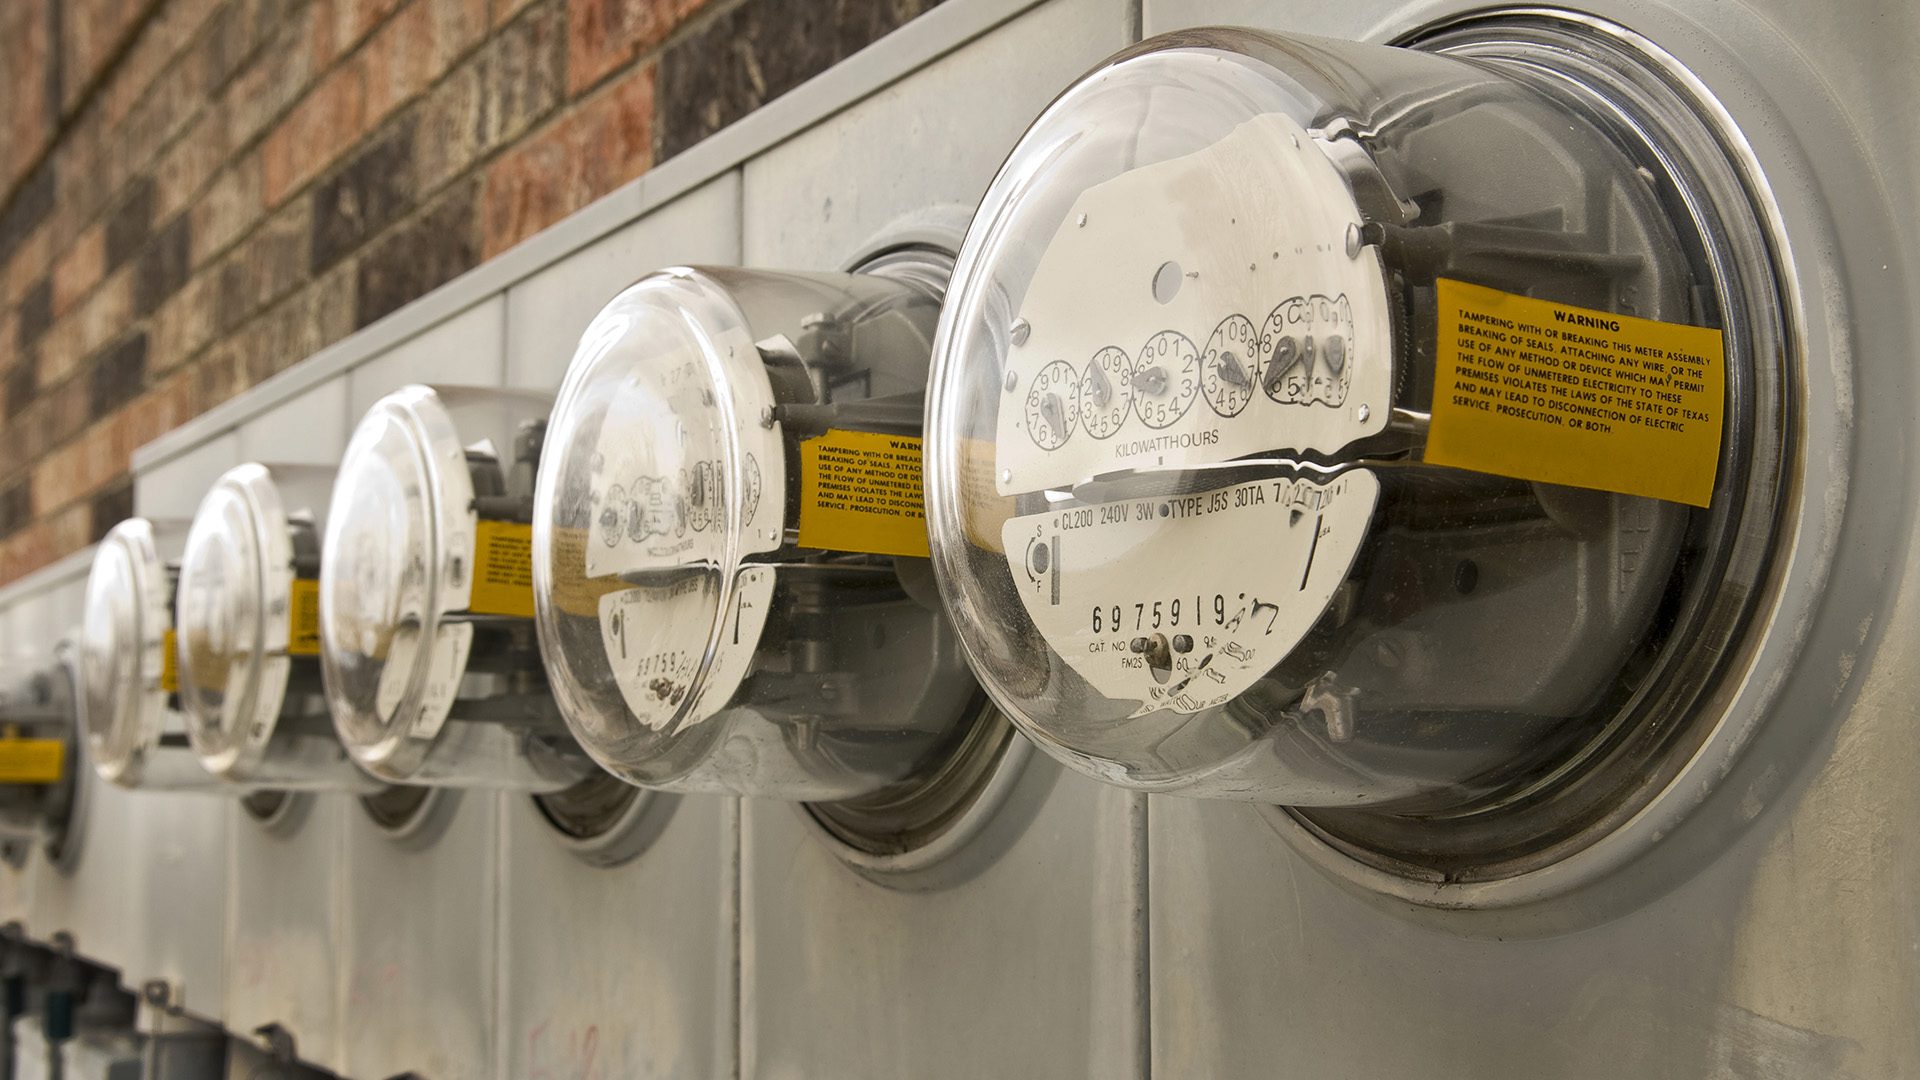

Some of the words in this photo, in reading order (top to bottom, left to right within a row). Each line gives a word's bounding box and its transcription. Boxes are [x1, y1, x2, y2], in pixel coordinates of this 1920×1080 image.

[1273, 314, 1283, 334] 9
[1554, 310, 1620, 332] WARNING
[1219, 329, 1223, 347] 1
[1229, 321, 1237, 340] 0
[1240, 324, 1247, 343] 9
[1458, 309, 1514, 329] TAMPERING
[1518, 323, 1541, 335] WITH
[1545, 328, 1558, 339] OR
[1561, 331, 1609, 349] BREAKING
[1612, 342, 1632, 352] THIS
[1634, 346, 1663, 358] METER
[1667, 352, 1710, 366] ASSEMBLY
[1158, 337, 1167, 356] 0
[1173, 339, 1179, 357] 1
[1247, 338, 1255, 358] 8
[1263, 334, 1271, 353] 8
[1458, 323, 1506, 342] BREAKING
[1510, 335, 1523, 345] OF
[1561, 346, 1615, 364] ATTACHING
[1619, 357, 1639, 367] ANY
[1671, 365, 1684, 376] OR
[1687, 369, 1703, 379] THE
[1103, 353, 1111, 371] 0
[1113, 355, 1121, 373] 9
[1146, 346, 1154, 365] 9
[1182, 354, 1193, 373] 2
[1207, 349, 1217, 368] 2
[1457, 338, 1474, 349] USE
[1478, 342, 1492, 352] OF
[1495, 346, 1516, 358] ANY
[1519, 352, 1560, 367] METHOD
[1563, 360, 1576, 371] OR
[1580, 364, 1612, 377] DEVICE
[1615, 370, 1646, 383] WHICH
[1649, 376, 1670, 387] MAY
[1674, 380, 1704, 393] PERMIT
[1040, 374, 1048, 391] 9
[1052, 367, 1059, 383] 0
[1064, 368, 1068, 384] 1
[1121, 368, 1129, 386] 8
[1208, 374, 1217, 394] 3
[1248, 365, 1254, 385] 7
[1457, 352, 1474, 364] THE
[1478, 356, 1505, 370] FLOW
[1508, 363, 1520, 373] OF
[1524, 366, 1579, 385] UNMETERED
[1582, 378, 1637, 395] ELECTRICITY
[1640, 388, 1653, 398] TO
[1656, 391, 1682, 404] THESE
[1069, 382, 1076, 400] 2
[1084, 377, 1093, 396] 2
[1181, 379, 1192, 398] 3
[1288, 376, 1300, 396] 5
[1456, 366, 1499, 383] PREMISES
[1503, 376, 1547, 393] VIOLATES
[1551, 385, 1567, 397] THE
[1571, 390, 1597, 402] LAWS
[1600, 395, 1613, 405] OF
[1616, 397, 1633, 409] THE
[1636, 401, 1662, 414] STATE
[1666, 406, 1679, 416] OF
[1682, 409, 1709, 422] TEXAS
[1031, 390, 1039, 407] 8
[1120, 392, 1128, 410] 7
[1168, 396, 1180, 415] 4
[1216, 388, 1225, 407] 4
[1228, 391, 1236, 410] 5
[1068, 405, 1076, 422] 3
[1084, 401, 1092, 419] 3
[1145, 401, 1152, 419] 6
[1157, 404, 1165, 423] 5
[1454, 381, 1476, 393] AND
[1480, 386, 1501, 398] MAY
[1505, 391, 1529, 404] LEAD
[1533, 396, 1545, 407] TO
[1548, 400, 1625, 422] DISCONNECTION
[1629, 414, 1642, 424] OF
[1645, 418, 1684, 433] ELECTRIC
[1031, 413, 1039, 430] 7
[1090, 414, 1098, 430] 4
[1100, 416, 1108, 433] 5
[1112, 408, 1120, 425] 6
[1569, 418, 1582, 429] OR
[1039, 425, 1047, 441] 6
[818, 445, 860, 456] TAMPERING
[1115, 429, 1219, 458] KILOWATTHOURS
[818, 455, 854, 465] BREAKING
[834, 474, 854, 482] FLOW
[869, 479, 911, 490] UNMETERED
[865, 469, 895, 478] METHOD
[818, 482, 851, 491] PREMISES
[853, 486, 887, 496] VIOLATES
[890, 490, 902, 498] THE
[818, 491, 834, 499] AND
[1062, 509, 1093, 530] CL200
[1100, 504, 1129, 525] 240V
[1136, 503, 1154, 521] 3W
[1168, 497, 1202, 519] TYPE
[1207, 491, 1228, 514] J5S
[1235, 485, 1265, 508] 30TA
[1036, 524, 1042, 538] S
[1037, 580, 1041, 593] F
[1121, 657, 1143, 669] FM2S
